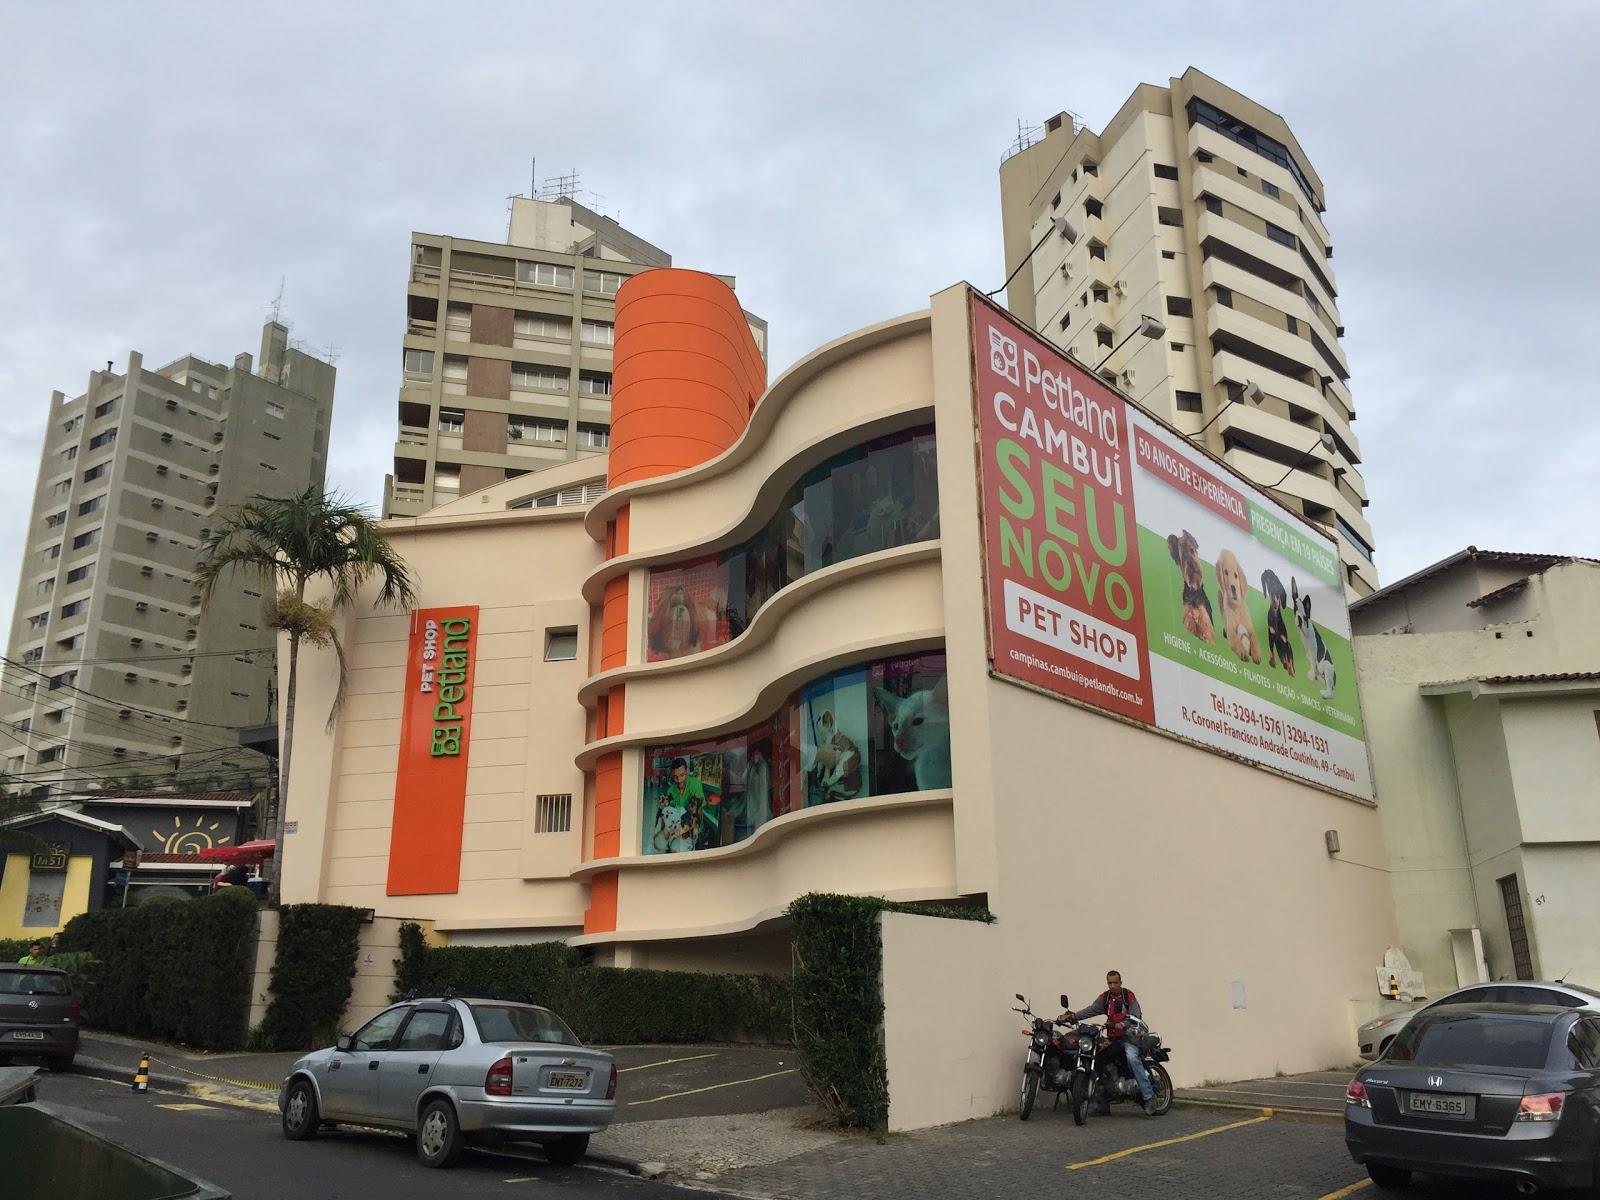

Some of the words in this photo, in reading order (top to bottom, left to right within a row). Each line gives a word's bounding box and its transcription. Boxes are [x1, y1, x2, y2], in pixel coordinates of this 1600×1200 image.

[1023, 348, 1120, 450] Petland
[993, 391, 1123, 497] CAMBUÍ
[1138, 436, 1151, 460] 50
[1152, 446, 1178, 477] ANOS
[1178, 462, 1192, 486] DE
[1191, 471, 1247, 521] EXPERIÊNCIA.
[995, 437, 1128, 567] SEU
[1000, 514, 1135, 621] NOVO
[1289, 534, 1302, 556] EM
[423, 619, 439, 661] SHOP
[1018, 596, 1062, 637] PET
[1069, 619, 1128, 663] SHOP
[420, 663, 436, 693] PET
[432, 617, 470, 722] Petland
[1163, 631, 1192, 654] HIGIENE
[1243, 667, 1271, 689] FILHOTES
[1300, 693, 1321, 711] SNACKS
[1181, 705, 1191, 722] R.
[1191, 709, 1223, 734] Coronel
[1223, 721, 1259, 747] Francisco
[1259, 735, 1289, 758] Andrade
[1289, 747, 1321, 772] Coutinho,
[1321, 759, 1329, 772] 49
[1209, 692, 1232, 717] Tel.:
[1232, 702, 1282, 736] 3294-1576
[1286, 724, 1330, 756] 3294-1531
[1413, 1098, 1433, 1111] EMY
